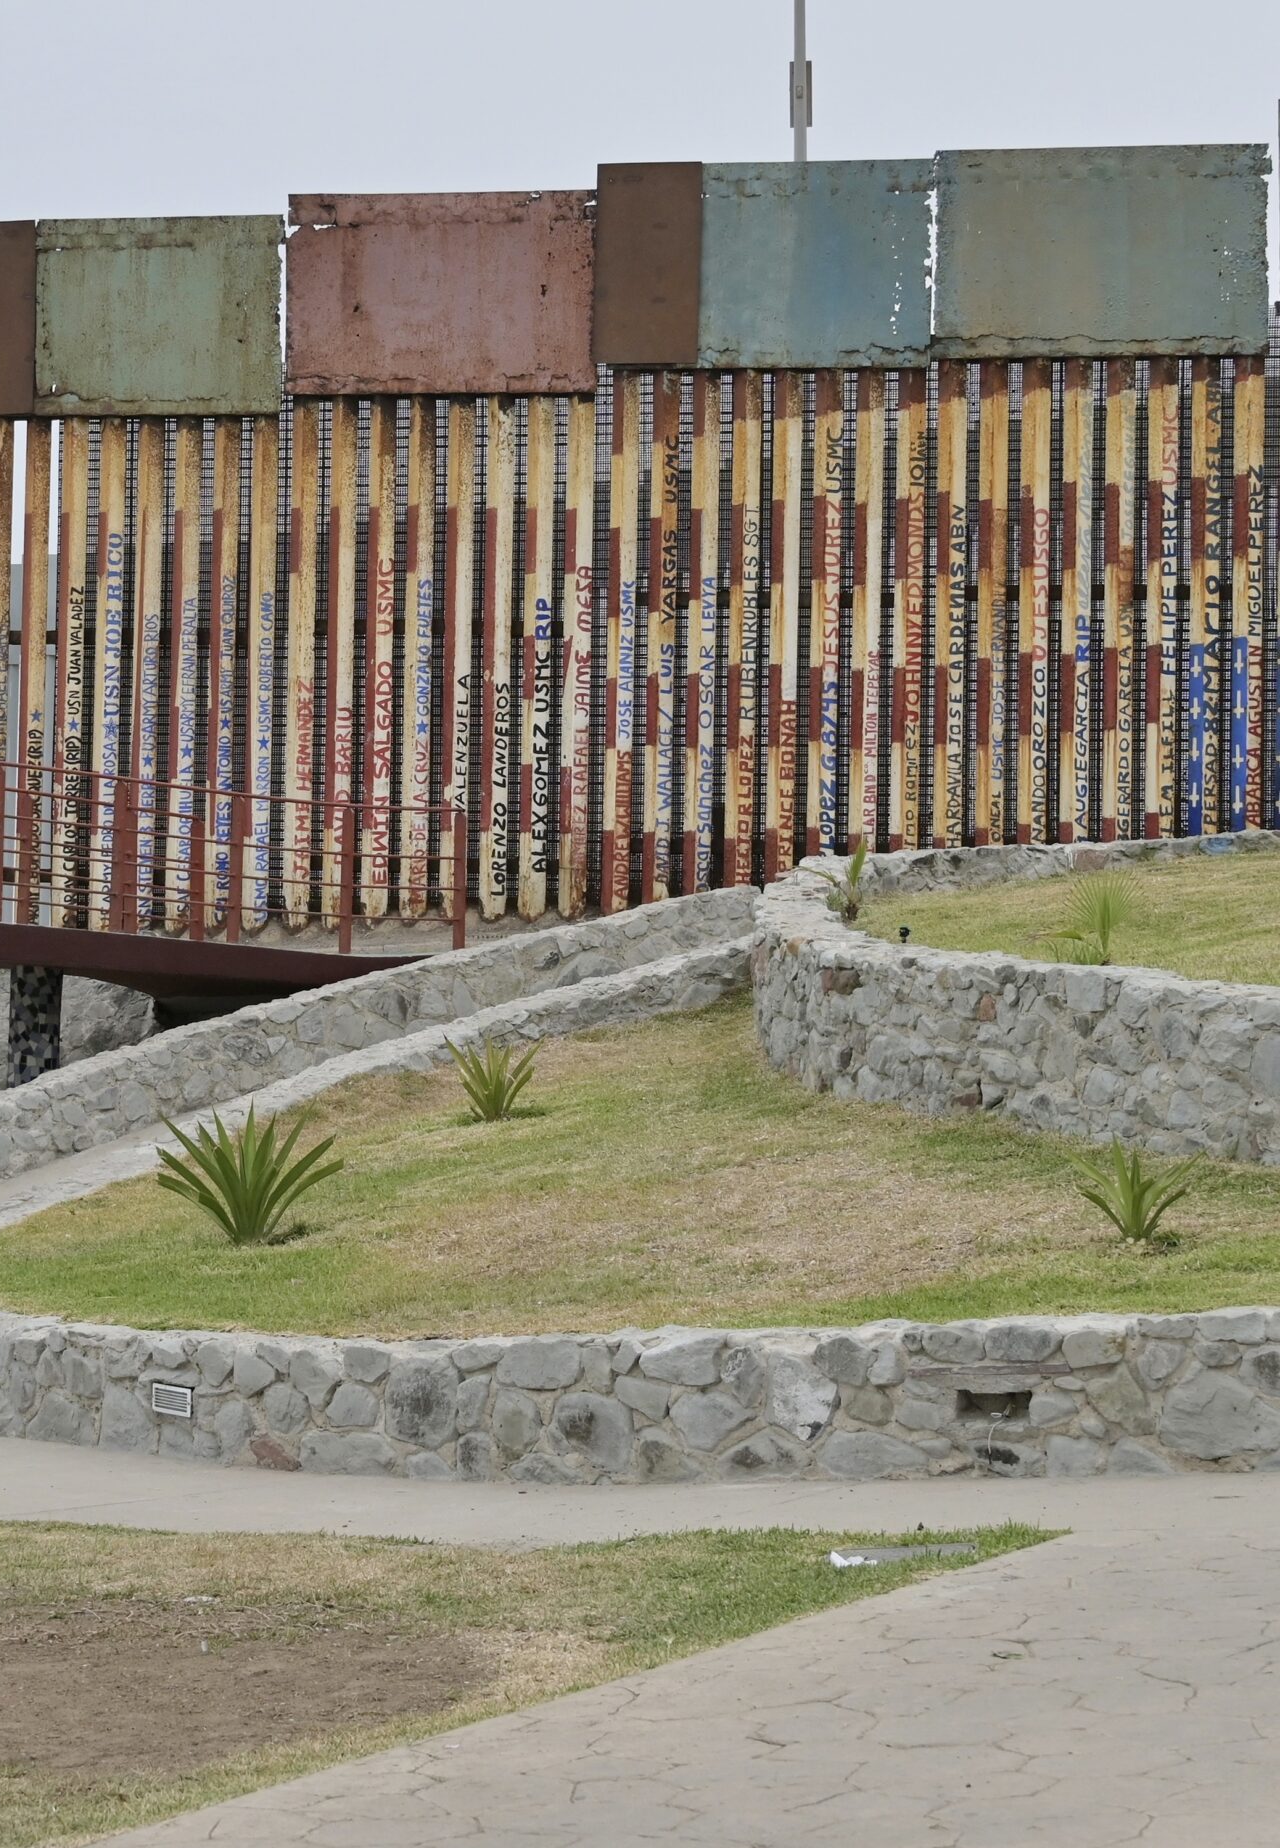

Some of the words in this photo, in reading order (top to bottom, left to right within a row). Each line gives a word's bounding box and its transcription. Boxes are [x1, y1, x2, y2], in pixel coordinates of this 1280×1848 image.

[662, 435, 679, 504] USMC
[826, 427, 844, 494] USMC
[1162, 405, 1178, 486] USMC
[952, 504, 965, 554] ABN
[1205, 437, 1221, 561] RANGEL
[824, 499, 842, 584] JUREZ
[1161, 489, 1178, 577] PEREZ
[106, 533, 124, 602] RICO
[222, 575, 237, 625] QUIROZ
[377, 557, 395, 636] USMC
[661, 529, 677, 625] VARGAS
[70, 586, 84, 645] VALADEZ
[104, 609, 122, 658] JOE
[144, 614, 159, 642] RIOS
[535, 598, 551, 641] RIP
[619, 580, 635, 627] USMC
[700, 577, 716, 632] LEVYA
[823, 592, 840, 671] JESUS
[949, 561, 965, 684] CARDENAS
[1161, 586, 1177, 675] FELIPE
[68, 649, 83, 685] JUAN
[258, 638, 274, 691] ROBERTO
[659, 643, 673, 695] LUIS
[1075, 615, 1090, 663] RIP
[68, 691, 80, 715] USN
[104, 664, 120, 717] USN
[257, 696, 272, 733] USMC
[416, 645, 431, 717] GONZALO
[534, 650, 550, 713] USMC
[575, 650, 591, 717] JAIME
[698, 646, 715, 729] OSCAR
[992, 681, 1005, 726] JOSE
[1118, 646, 1131, 733] GARCIA
[295, 678, 314, 791] HERNANDEZ
[373, 661, 393, 779] SALGADO
[453, 674, 471, 813] VALENZUELA
[492, 683, 510, 788] LANDEROS
[618, 700, 632, 739] JOSE
[780, 700, 796, 779] BONAH
[864, 712, 877, 758] MILTON
[948, 691, 962, 748] JOSE
[415, 740, 429, 785] CRUZ
[572, 726, 588, 796] RAFAEL
[657, 728, 673, 812] WALLACE
[991, 733, 1004, 781] USMC
[1246, 747, 1261, 827] ABARCA
[292, 801, 310, 879] JAIME
[371, 797, 389, 885] EDWIN
[414, 824, 427, 841] DE
[778, 788, 795, 872] PRINCE
[904, 810, 916, 846] rmo
[1032, 776, 1045, 843] NANDO
[1160, 785, 1174, 833] LEM
[255, 819, 270, 872] RAFAEL
[490, 802, 507, 896] LORENZO
